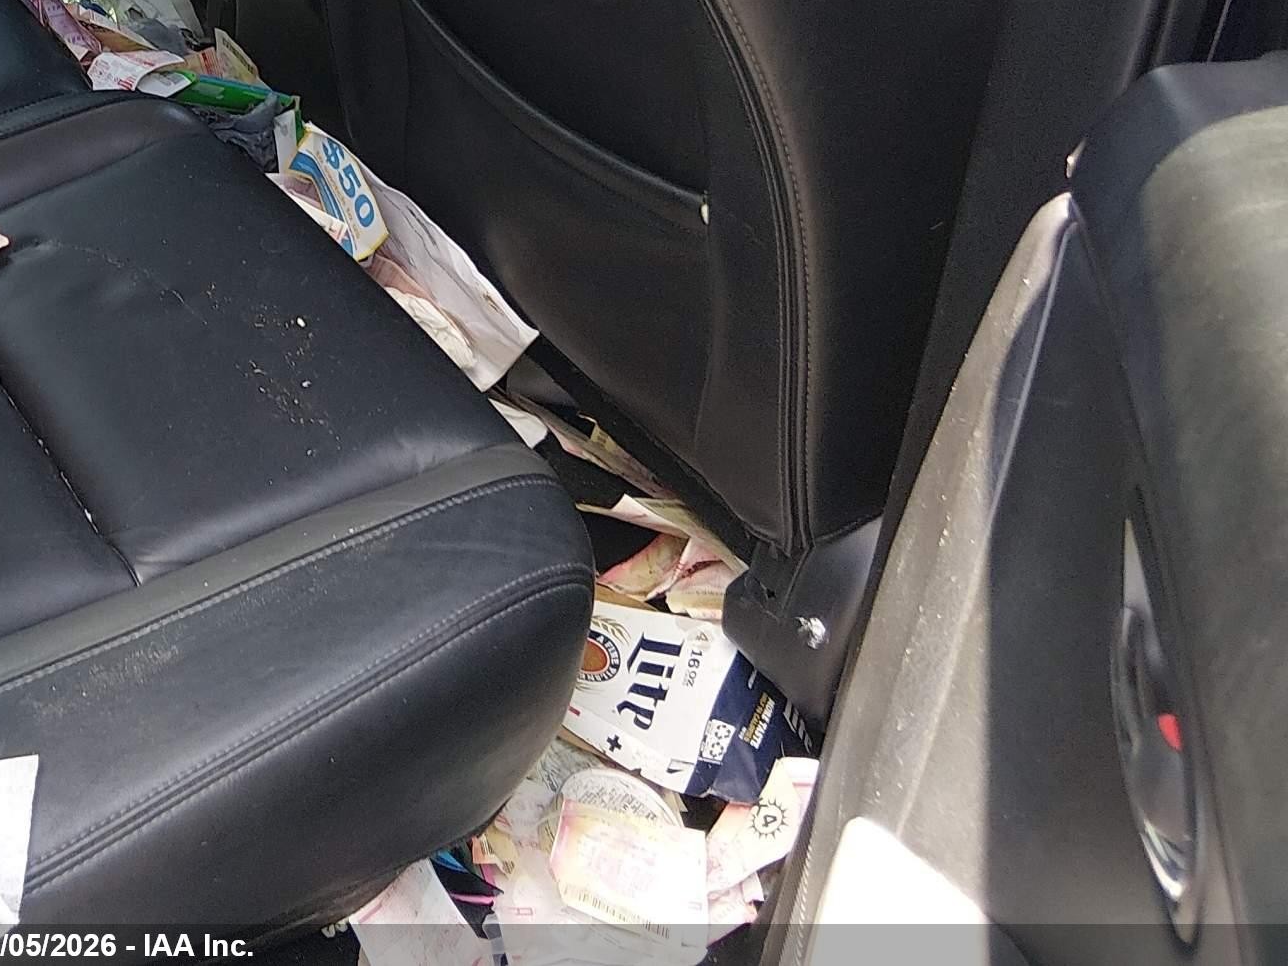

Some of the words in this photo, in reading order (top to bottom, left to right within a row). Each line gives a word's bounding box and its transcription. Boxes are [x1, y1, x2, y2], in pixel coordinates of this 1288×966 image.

[320, 138, 377, 230] $50
[616, 632, 685, 730] Lite
[760, 813, 775, 828] 4
